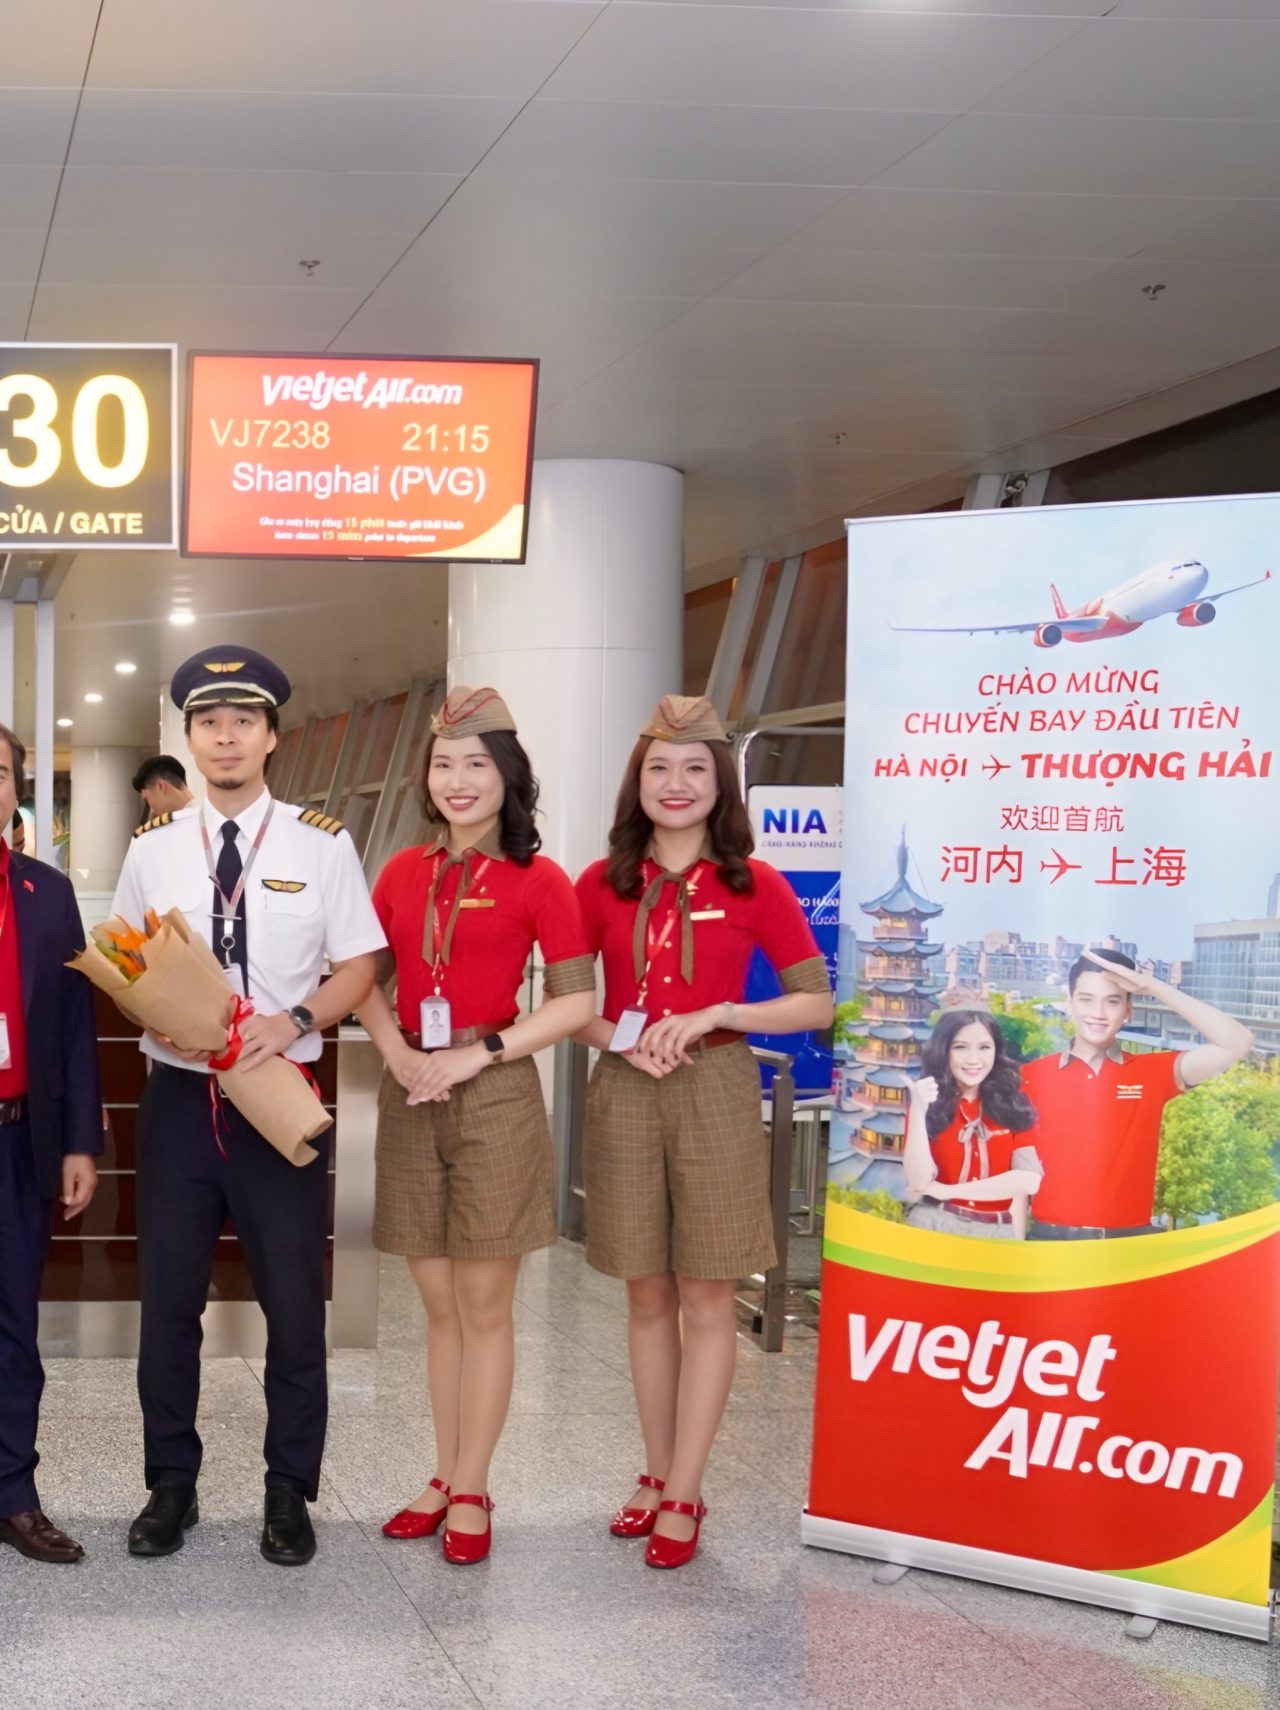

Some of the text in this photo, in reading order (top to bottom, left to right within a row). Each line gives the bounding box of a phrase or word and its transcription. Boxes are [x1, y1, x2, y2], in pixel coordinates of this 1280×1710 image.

[210, 418, 490, 453] VJ7238 21:15
[232, 462, 486, 503] Shanghai (PVG)
[53, 511, 65, 534] /
[70, 511, 143, 534] GATE
[978, 666, 1159, 696] CHÀO MỪNG
[904, 701, 1240, 734] CHUYẾN BAY ĐẦU TIÊN
[874, 738, 1273, 787] HÀ NỘI THƯỢNG HẢI
[763, 808, 828, 834] NIA
[1000, 805, 1125, 833] 欢迎首航
[940, 844, 1187, 887] 河内 上海
